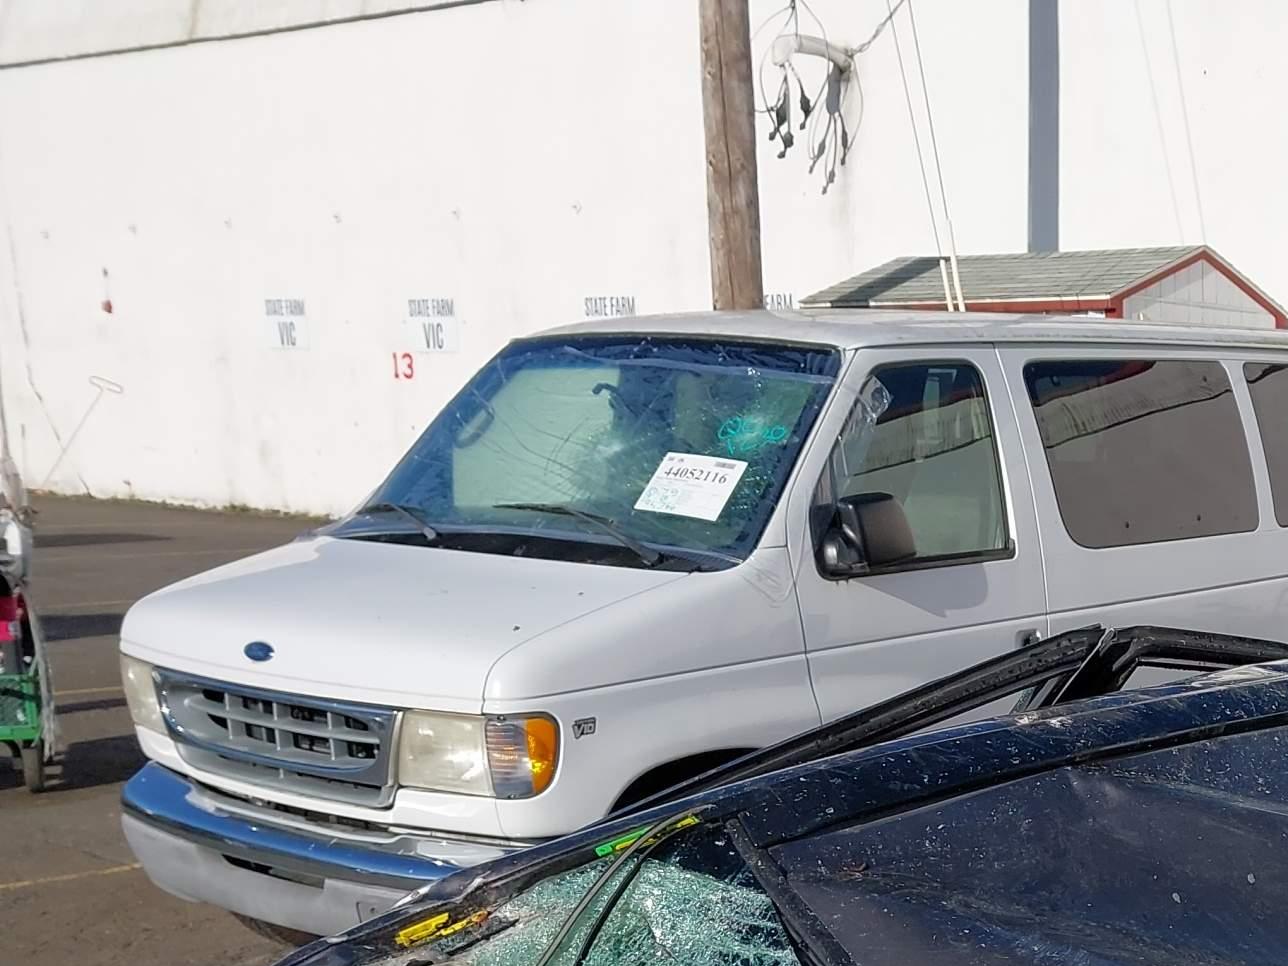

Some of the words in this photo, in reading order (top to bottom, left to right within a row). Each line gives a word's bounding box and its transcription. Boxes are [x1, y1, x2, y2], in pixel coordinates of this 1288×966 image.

[265, 299, 284, 316] STATE
[285, 299, 305, 316] FARM
[408, 299, 430, 317] STATE
[432, 299, 454, 317] FARM
[585, 297, 608, 316] STATE
[610, 297, 635, 315] FARM
[278, 321, 297, 346] VIC
[423, 322, 444, 349] VIC
[392, 352, 414, 379] 13
[664, 466, 729, 484] 44052116
